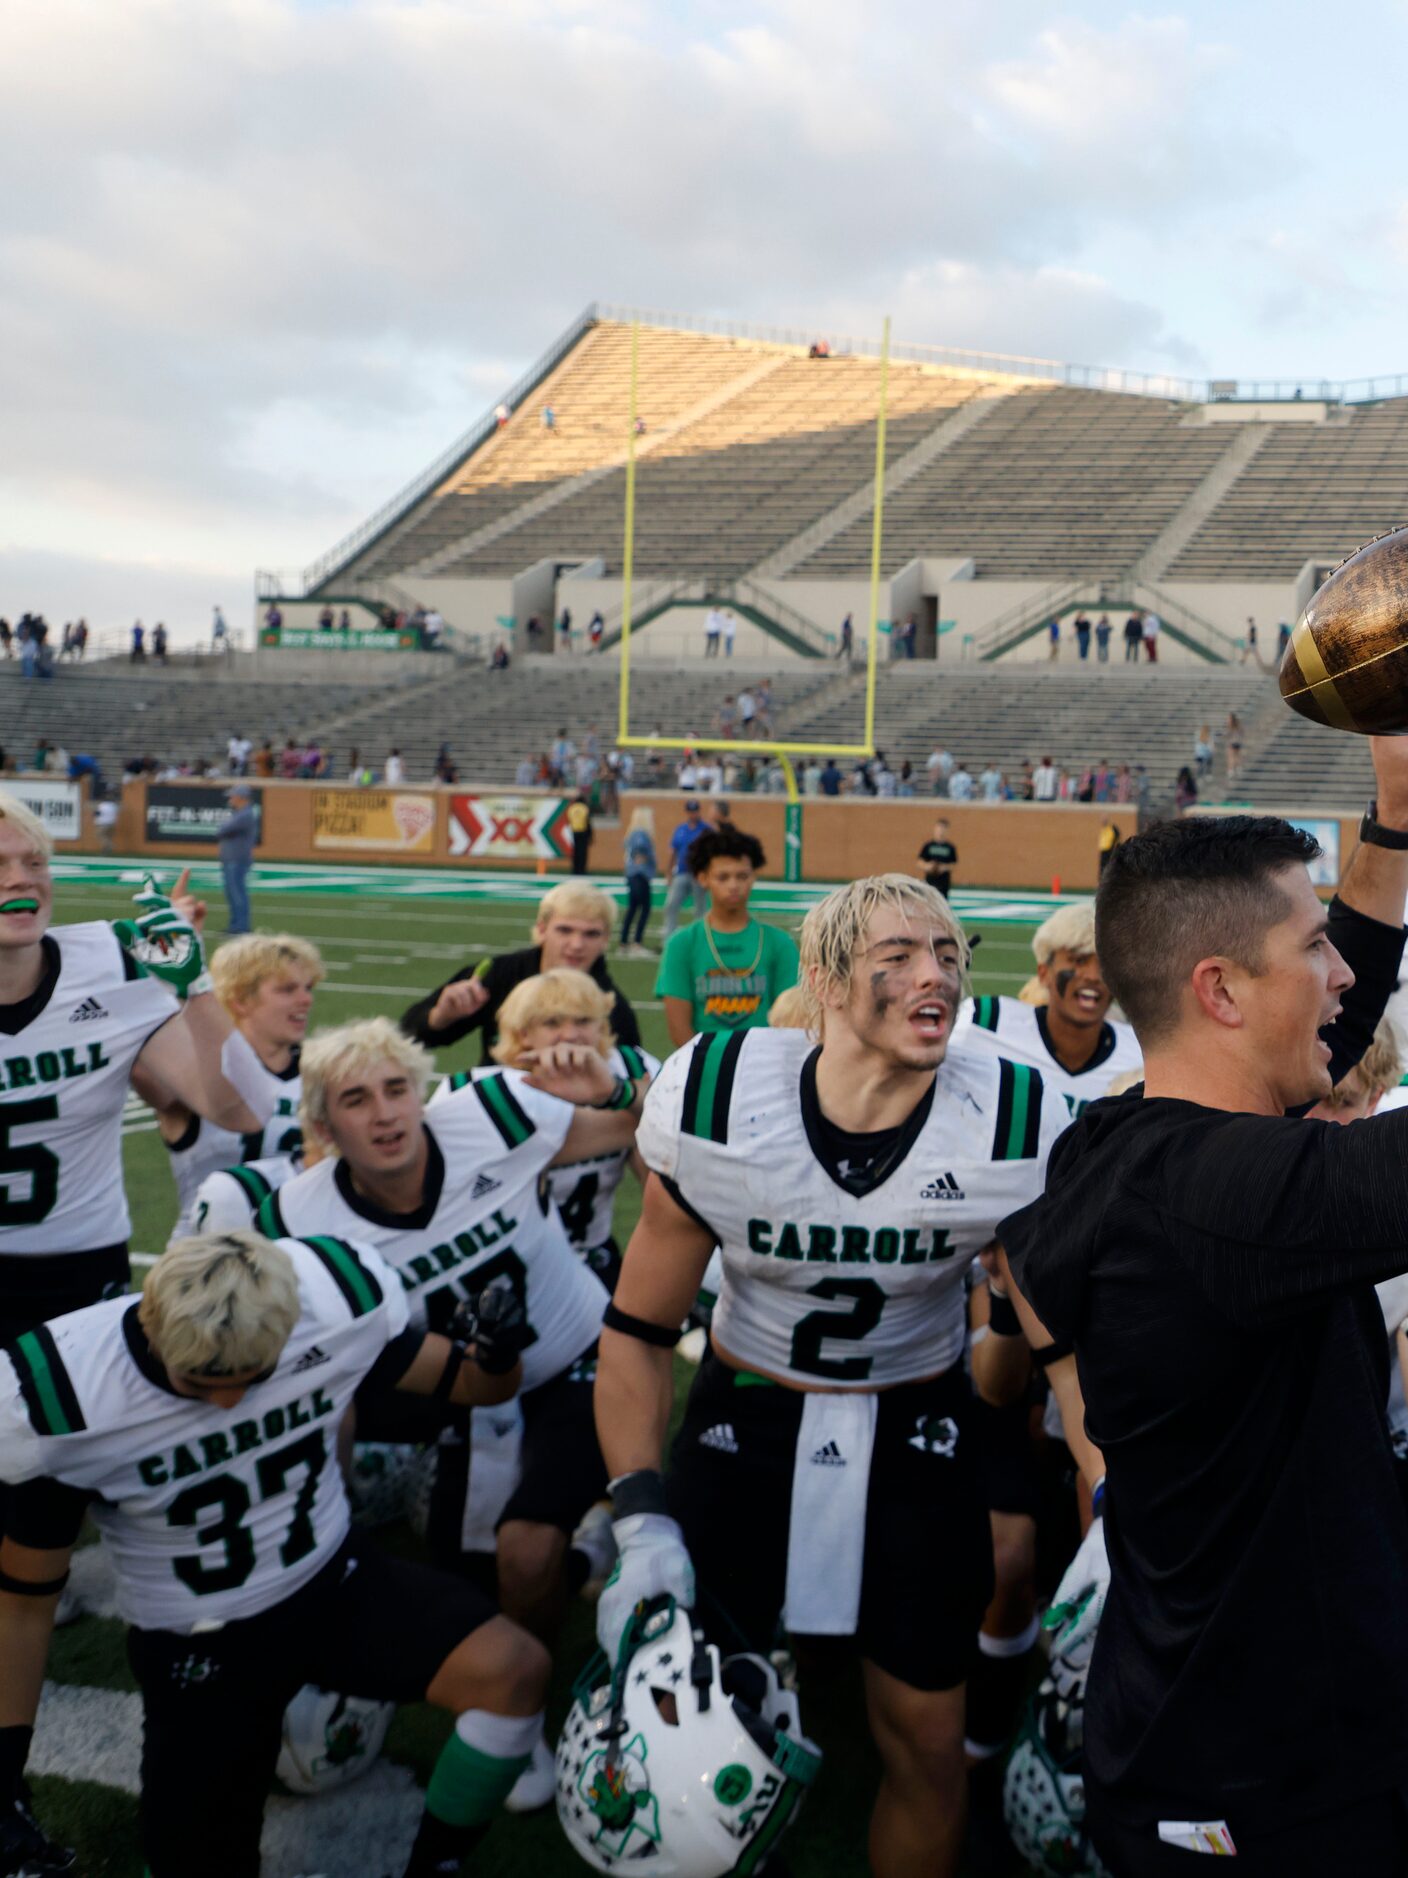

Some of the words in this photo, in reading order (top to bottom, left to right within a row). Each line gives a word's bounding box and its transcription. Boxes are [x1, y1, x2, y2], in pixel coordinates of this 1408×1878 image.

[747, 1219, 956, 1264] CARROLL
[920, 1190, 965, 1200] adidas
[789, 1277, 887, 1381] 2
[137, 1385, 334, 1487] CARROLL
[166, 1428, 327, 1597] 37
